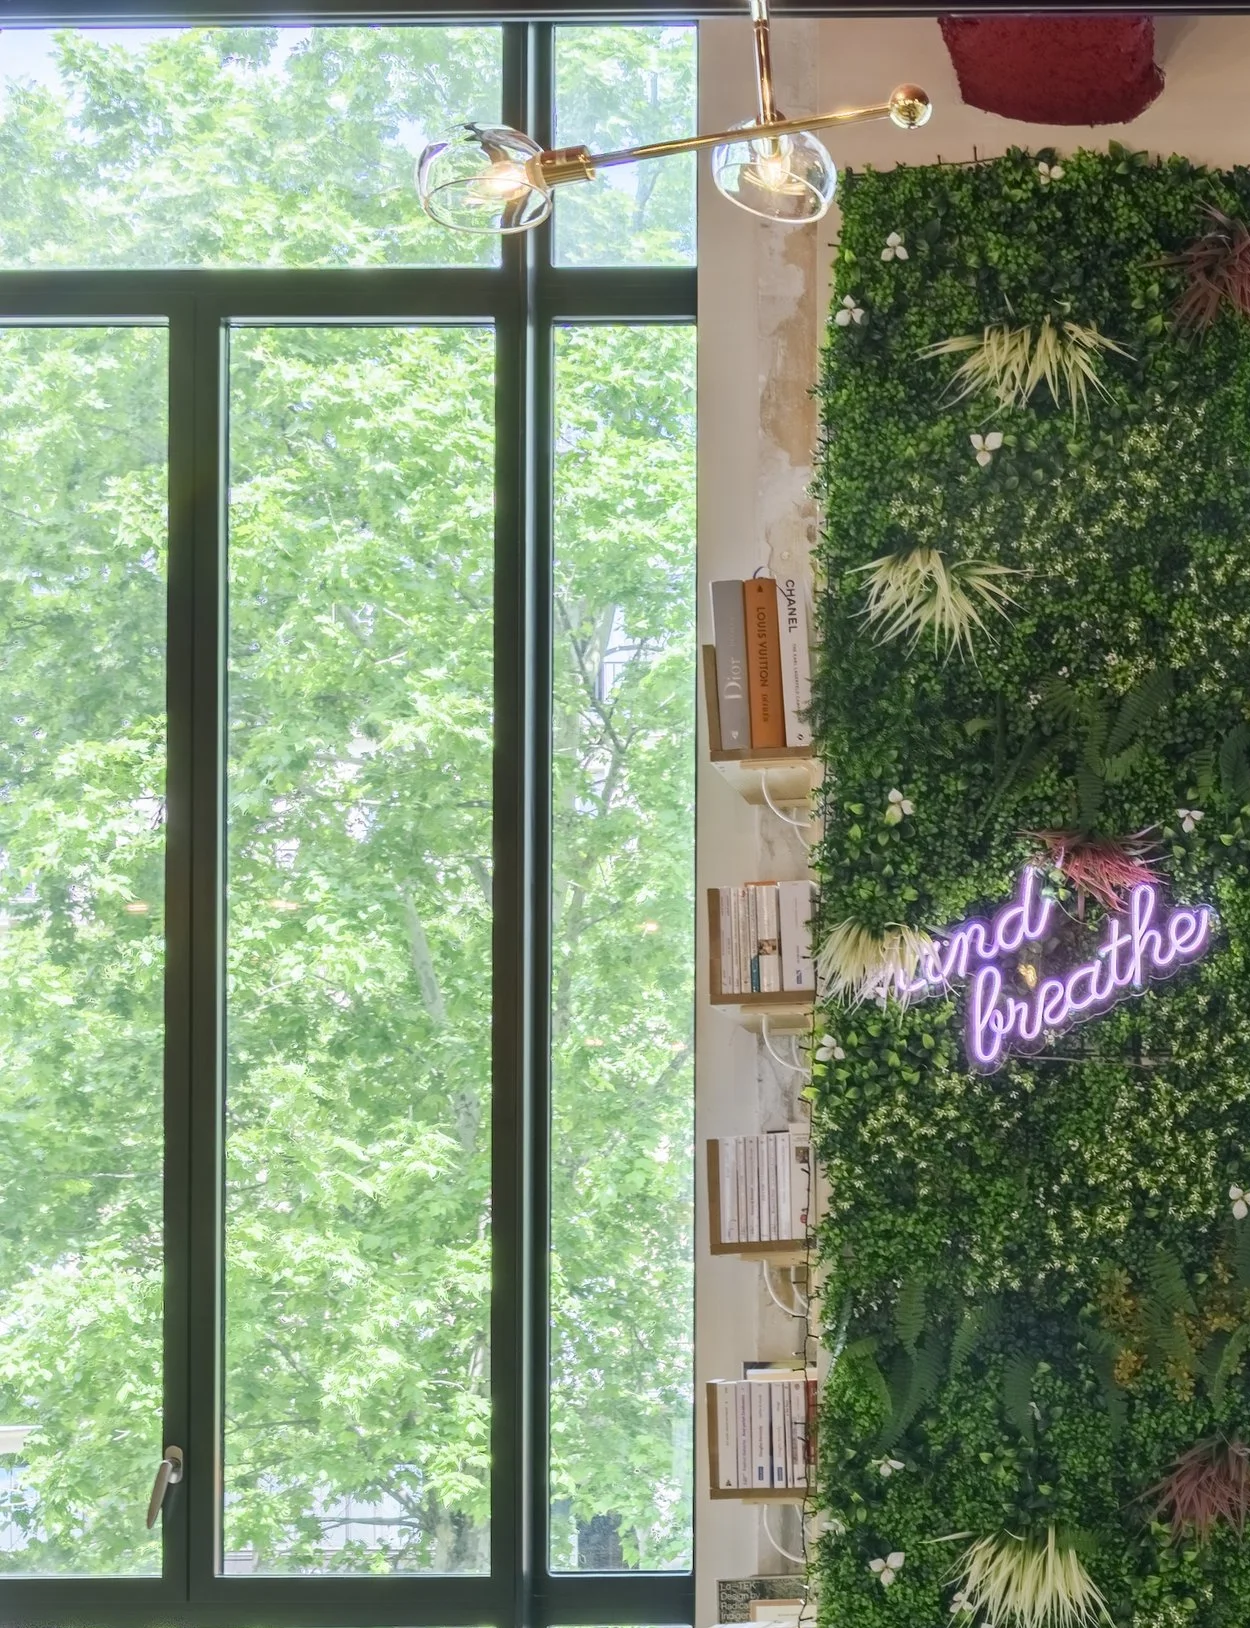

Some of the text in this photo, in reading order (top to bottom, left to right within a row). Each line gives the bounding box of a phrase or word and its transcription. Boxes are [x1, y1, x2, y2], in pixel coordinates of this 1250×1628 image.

[756, 607, 767, 639] LOUIS
[785, 579, 798, 633] CHANEL
[724, 656, 742, 700] Dior
[758, 642, 769, 687] VUITTON
[970, 883, 1211, 1063] breathe
[721, 1593, 749, 1602] Design
[721, 1602, 748, 1610] Radica
[721, 1612, 751, 1621] Indigen
